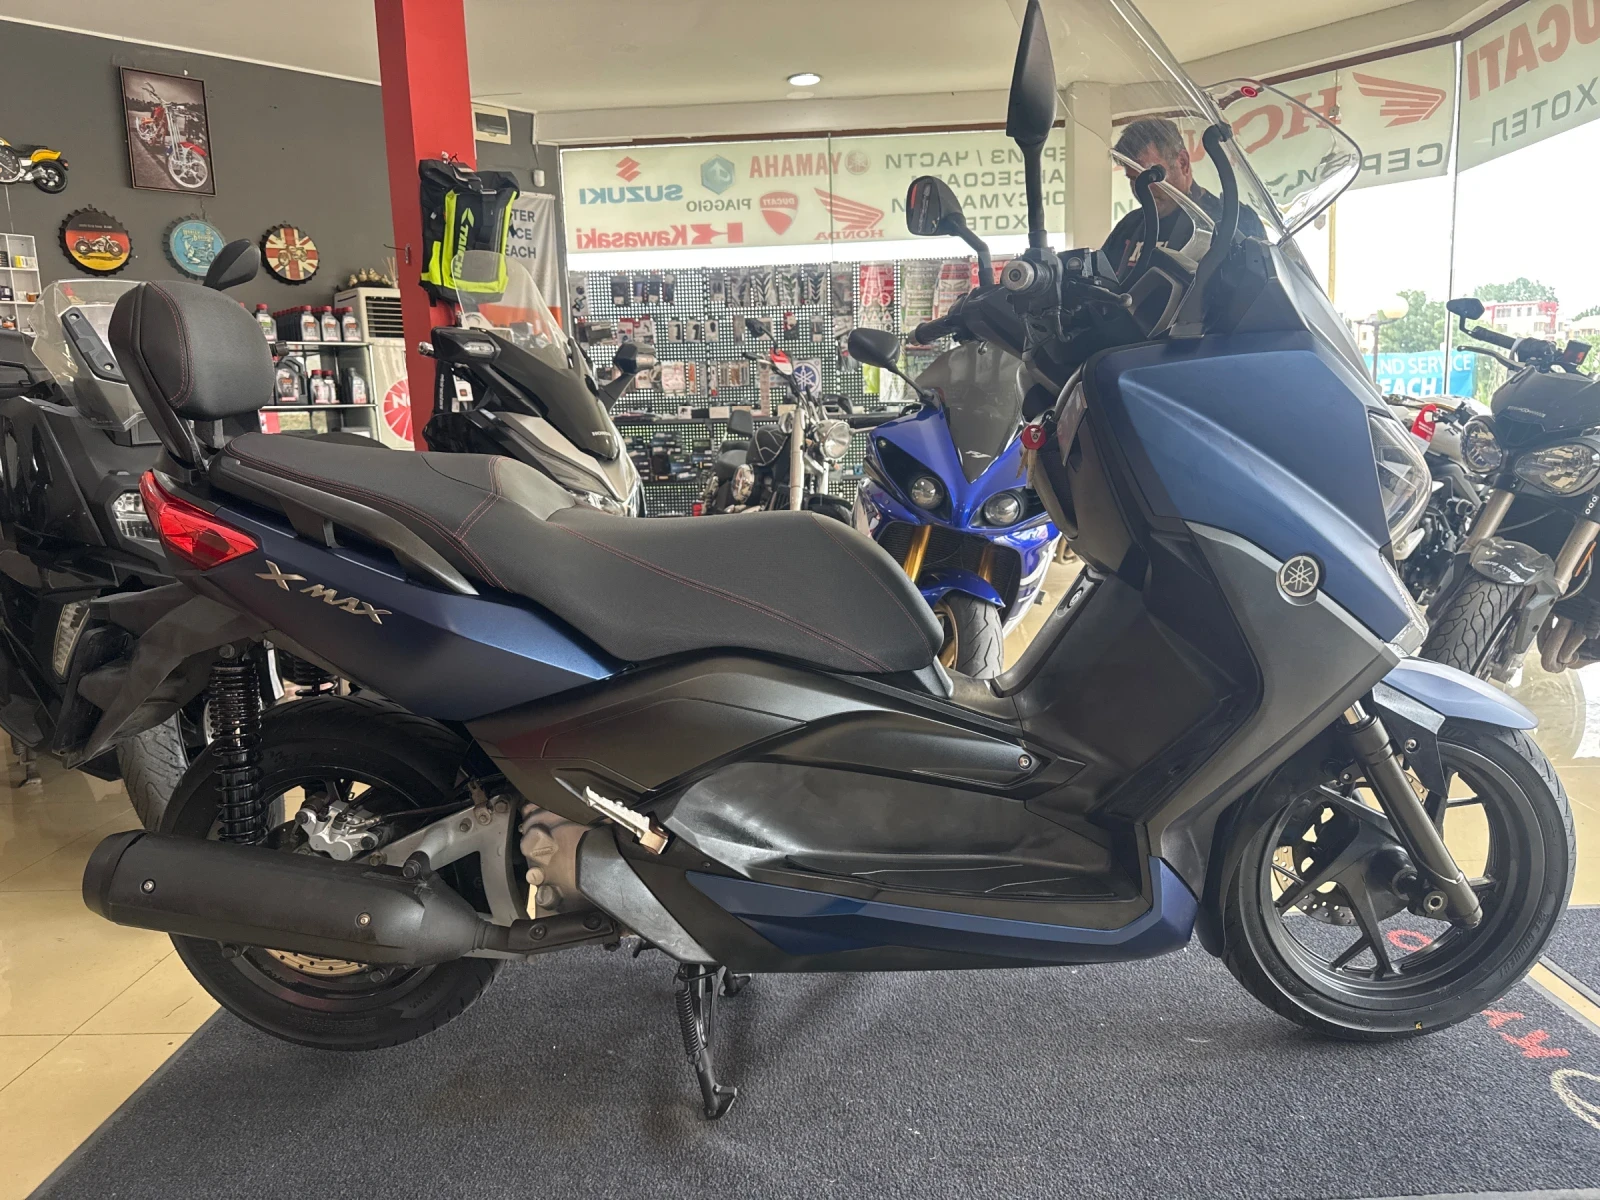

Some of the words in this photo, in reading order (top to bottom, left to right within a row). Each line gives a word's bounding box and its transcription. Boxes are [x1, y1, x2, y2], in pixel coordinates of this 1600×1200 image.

[511, 208, 535, 222] TER
[513, 227, 532, 240] CE
[505, 244, 536, 259] EACH
[1378, 377, 1437, 396] EACH
